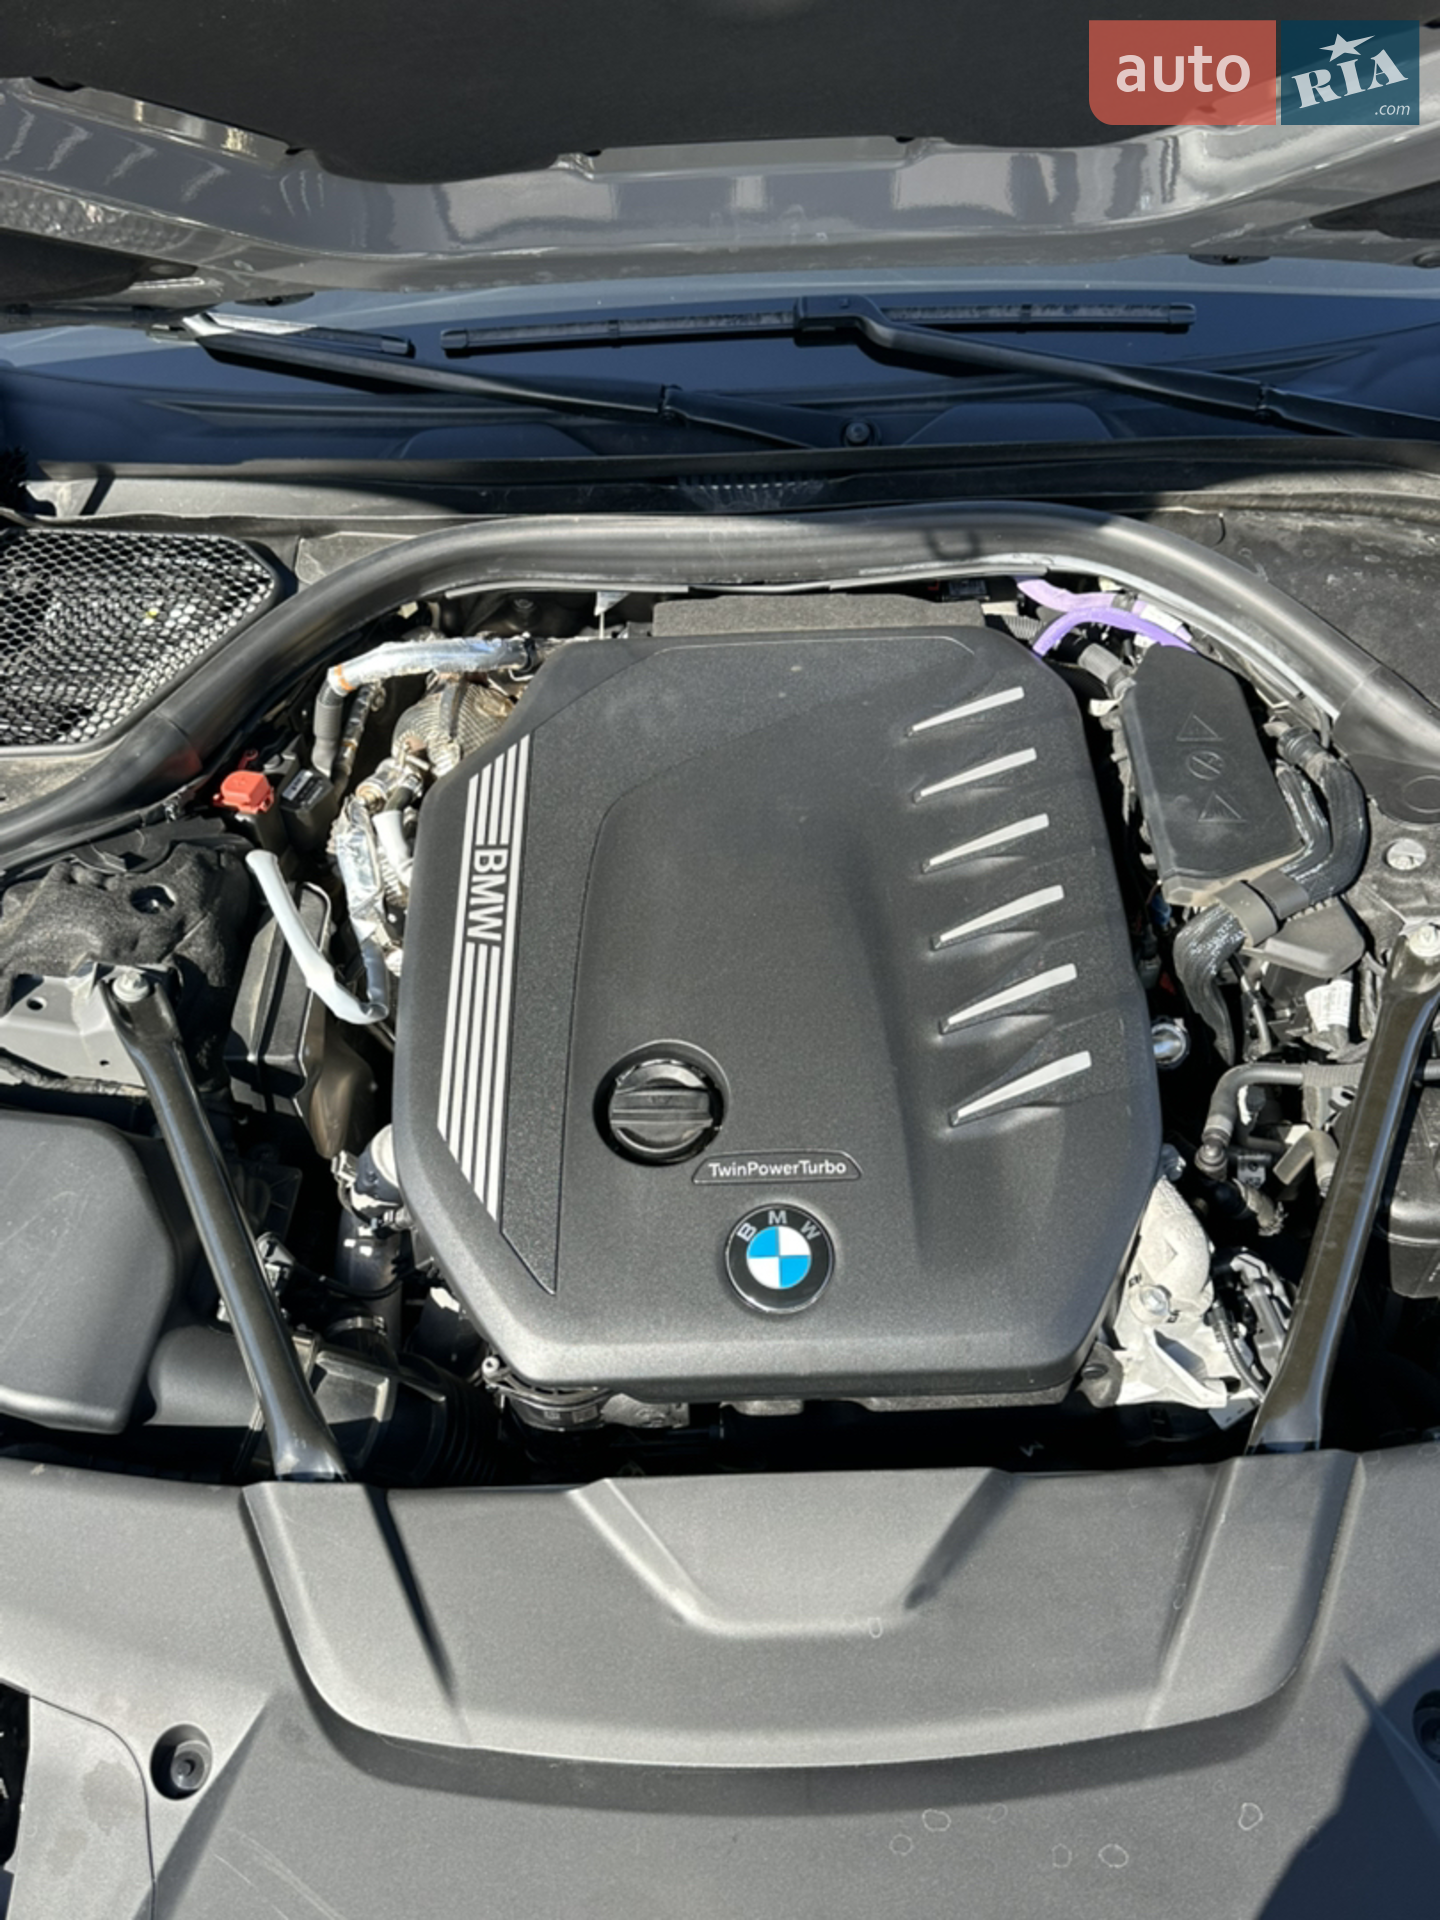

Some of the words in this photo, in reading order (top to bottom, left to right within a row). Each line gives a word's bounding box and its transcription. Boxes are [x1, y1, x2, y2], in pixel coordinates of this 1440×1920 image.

[466, 849, 509, 941] BMW
[708, 1159, 847, 1177] TwinPowerTurbo
[736, 1210, 822, 1242] BMW
